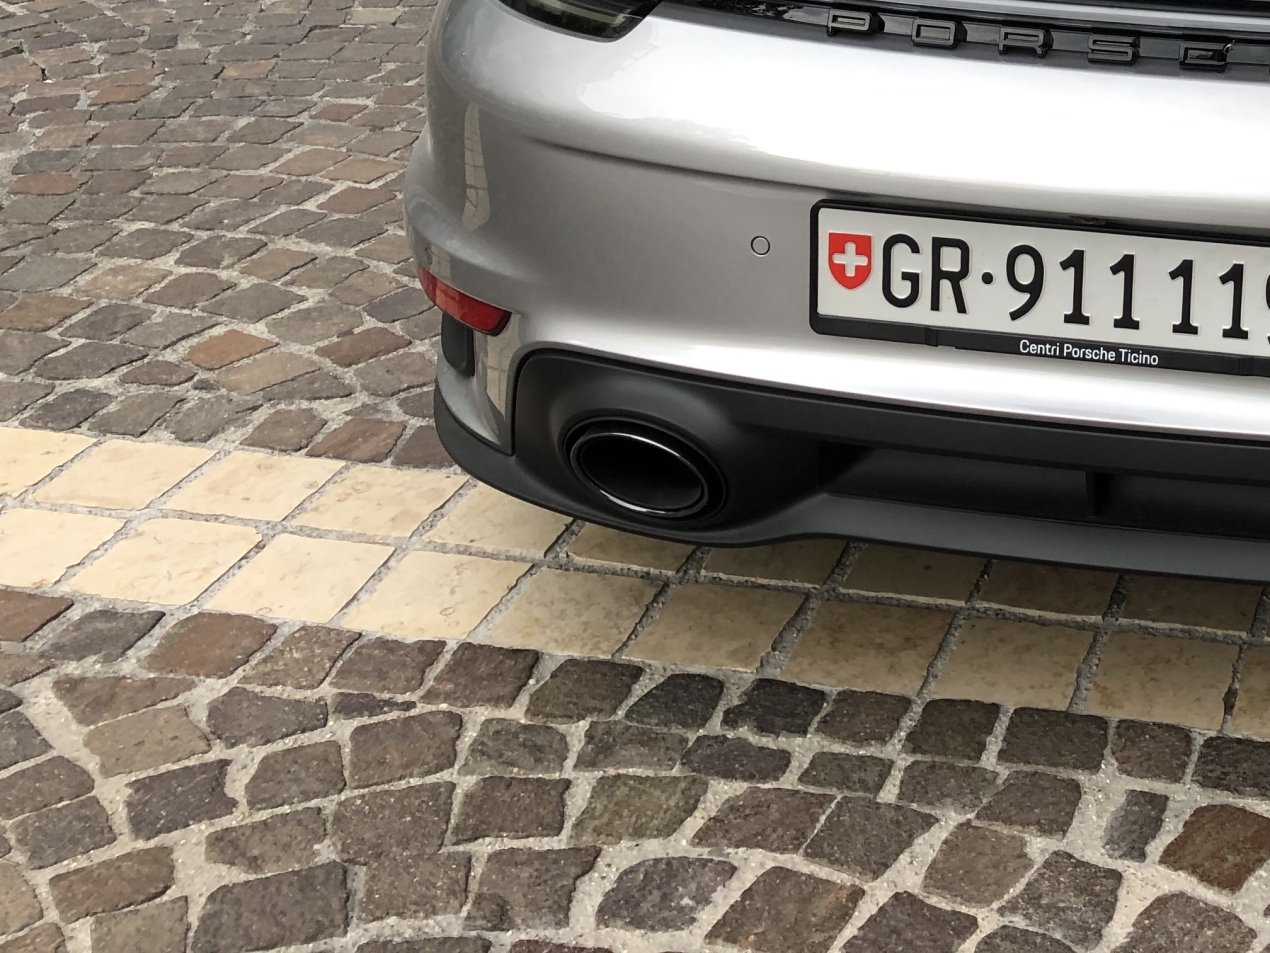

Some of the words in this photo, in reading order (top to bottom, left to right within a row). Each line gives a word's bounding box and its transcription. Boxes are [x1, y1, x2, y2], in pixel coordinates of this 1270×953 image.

[1019, 339, 1060, 356] Centri
[1063, 343, 1116, 361] Porsche
[1119, 348, 1159, 365] Ticino
